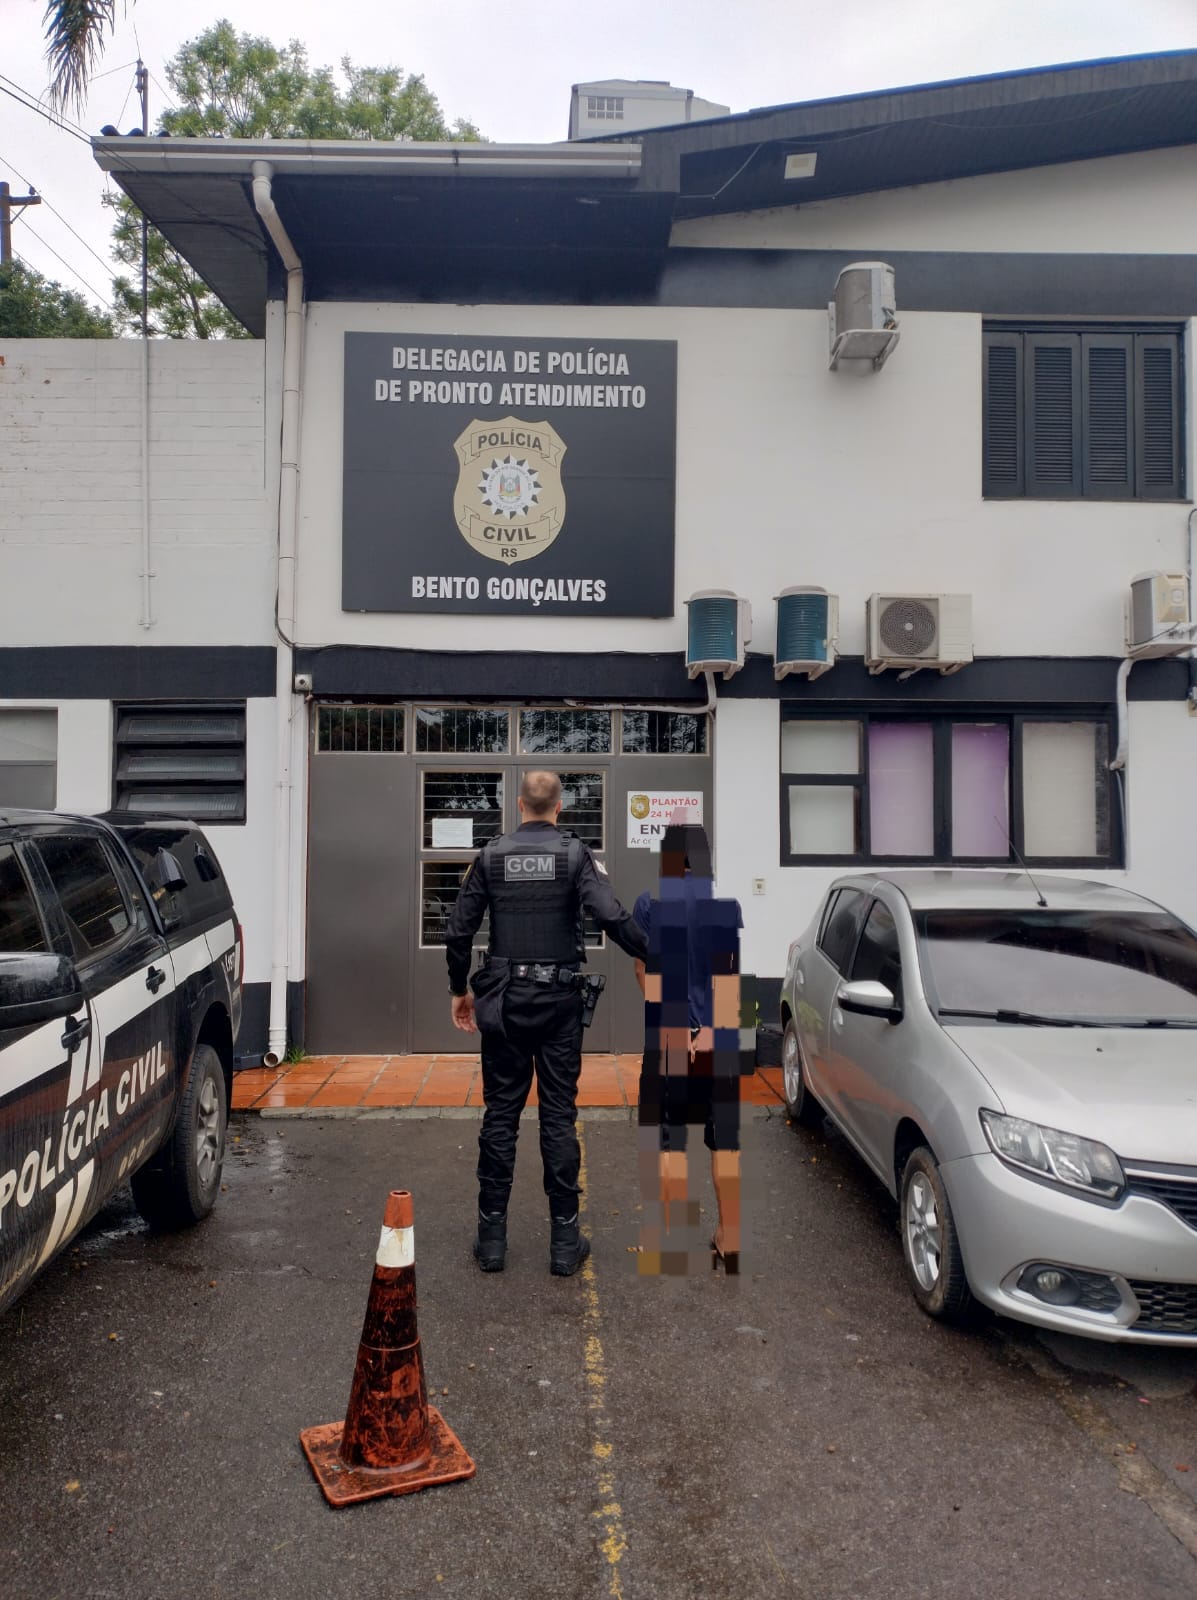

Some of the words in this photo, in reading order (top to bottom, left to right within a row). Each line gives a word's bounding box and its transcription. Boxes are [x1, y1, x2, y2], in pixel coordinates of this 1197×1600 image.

[392, 347, 507, 373] DELEGACIA
[514, 350, 540, 374] DE
[547, 347, 630, 376] POLÍCIA
[375, 379, 401, 402] DE
[408, 381, 493, 405] PRONTO
[499, 383, 646, 409] ATENDIMENTO
[477, 428, 543, 451] POLÍCIA
[483, 526, 537, 542] CIVIL
[501, 548, 518, 558] RS
[411, 576, 480, 600] BENTO
[487, 578, 607, 606] GONÇALVES
[651, 797, 698, 806] PLANTÃO
[651, 810, 661, 818] 24
[507, 857, 553, 872] GCM
[0, 1087, 110, 1230] POLÍCIA
[116, 1040, 166, 1117] CIVIL
